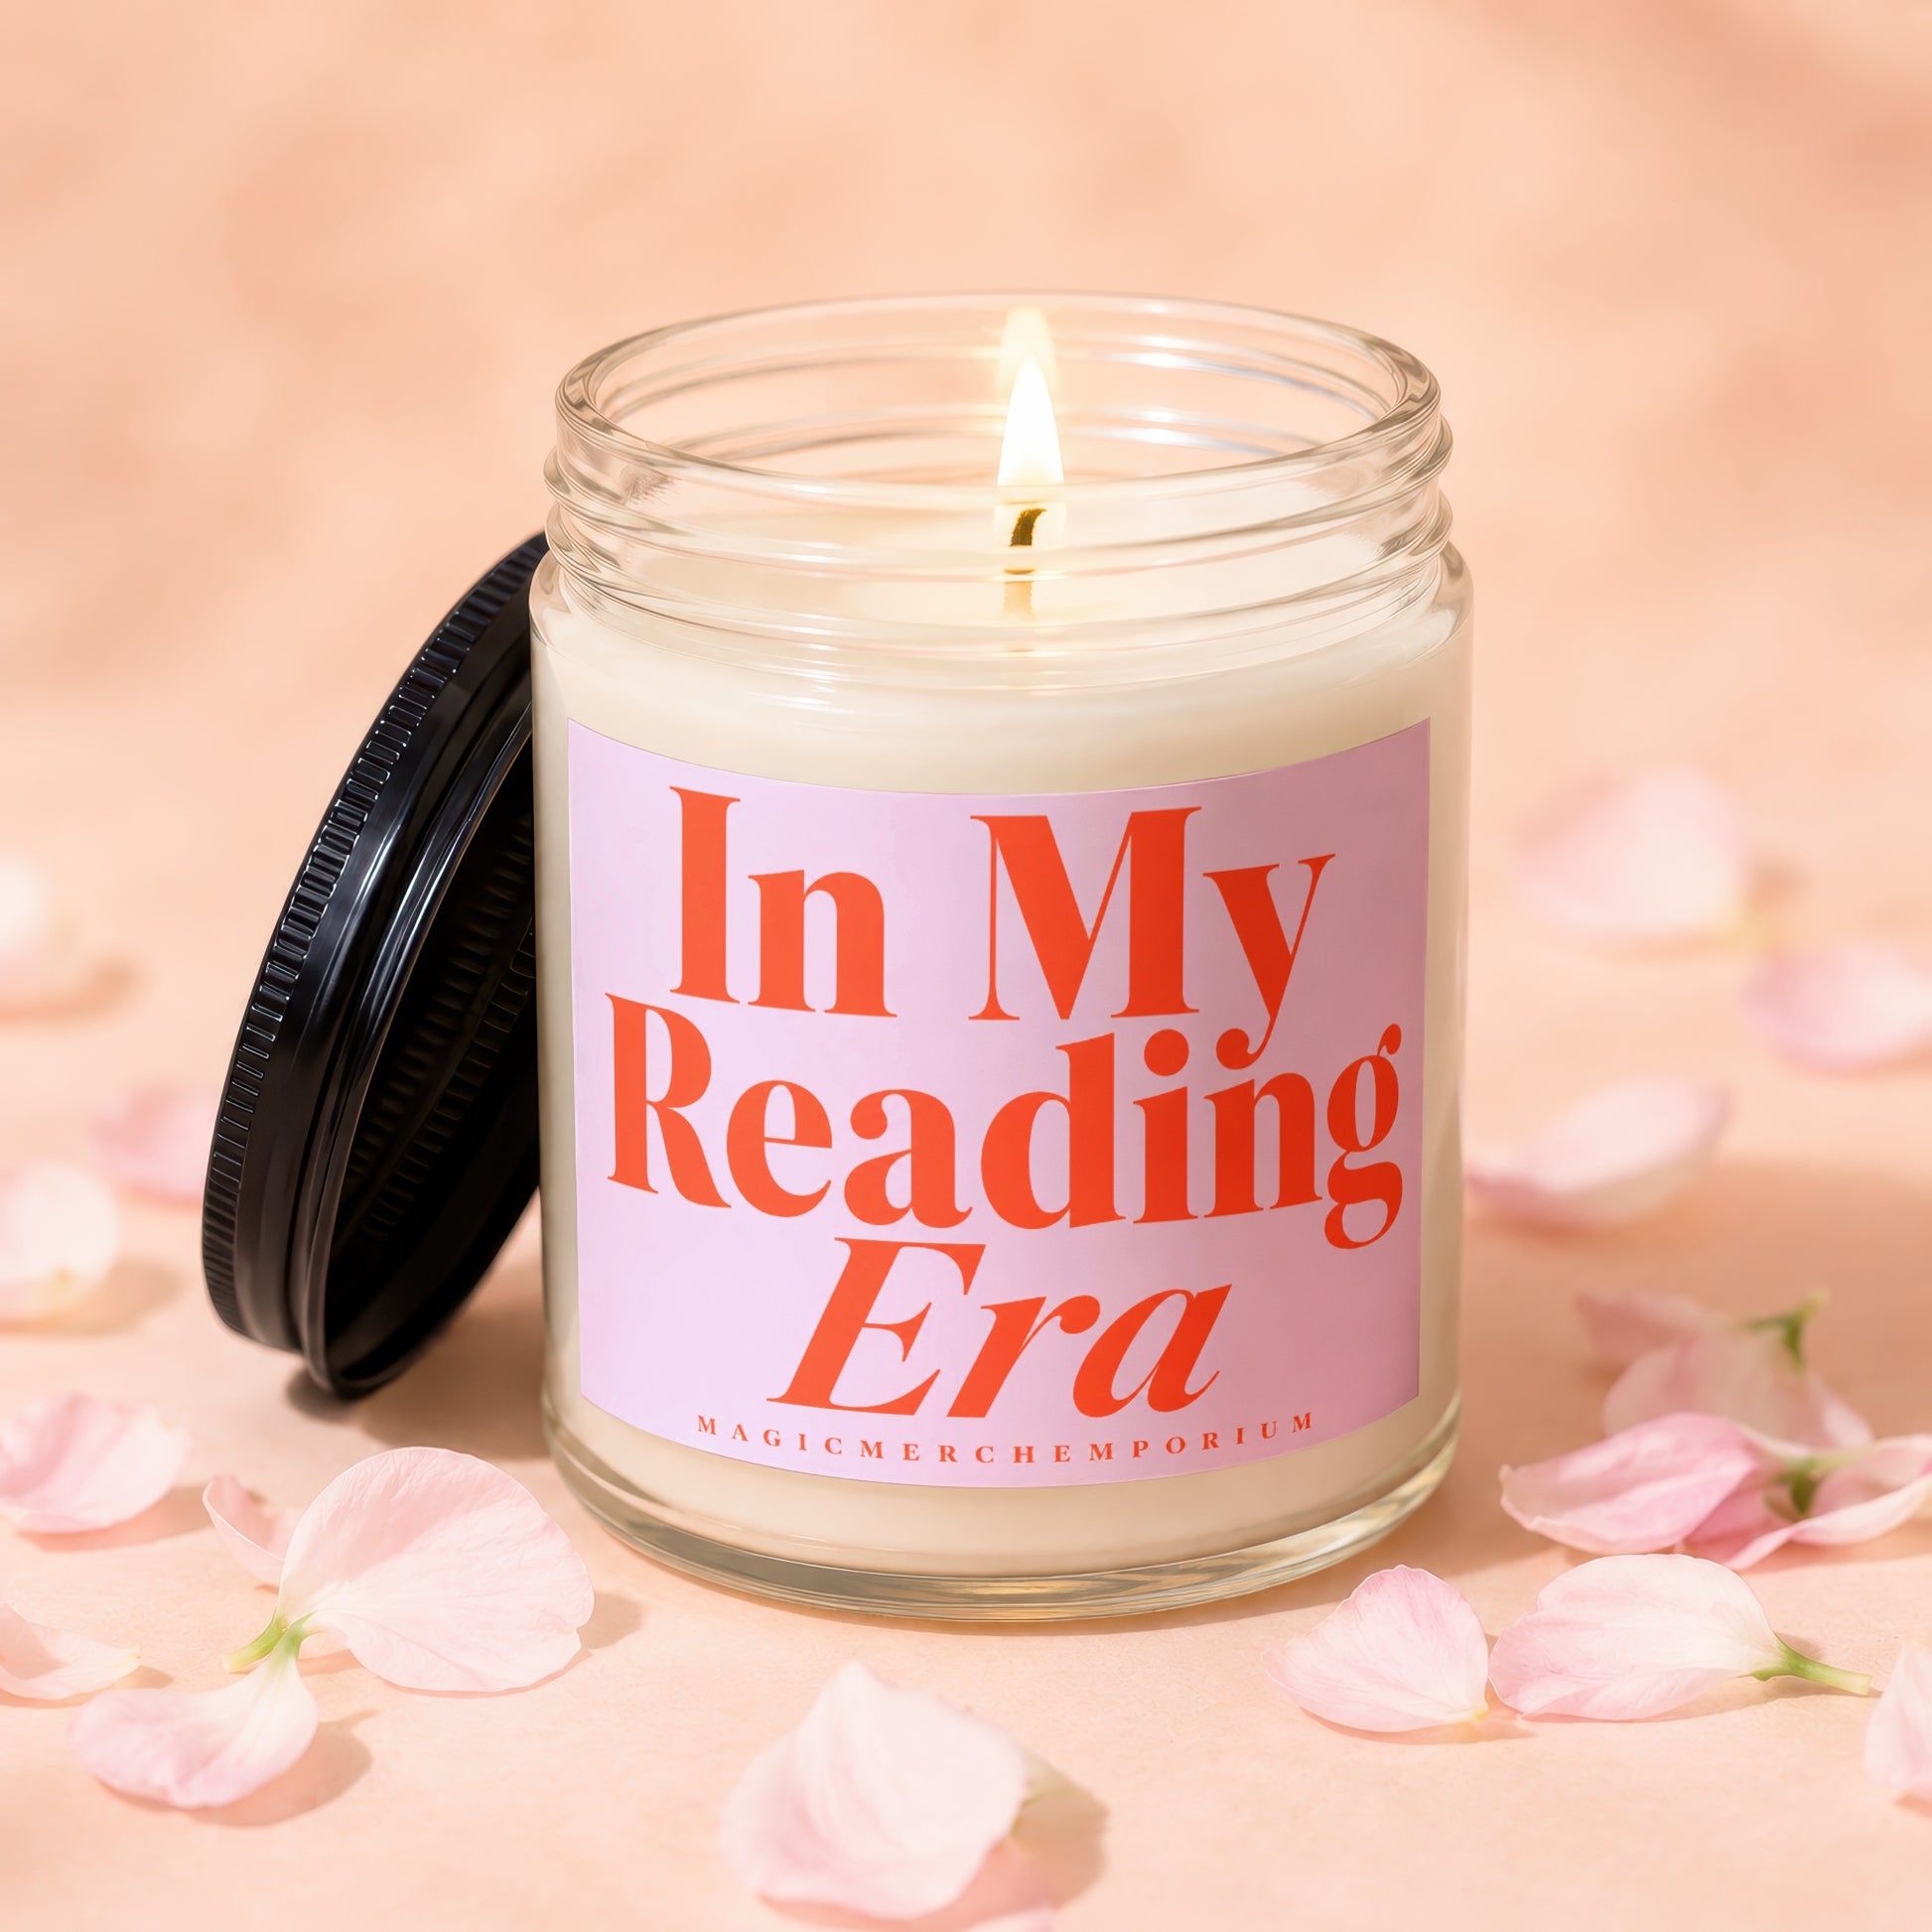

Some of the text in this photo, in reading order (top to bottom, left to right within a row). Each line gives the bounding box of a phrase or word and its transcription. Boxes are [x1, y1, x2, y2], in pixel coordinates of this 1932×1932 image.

[669, 785, 1336, 1071] In My
[605, 993, 1404, 1251] Reading
[697, 1412, 1313, 1463] MAGICMERCHEMPORIUM
[766, 1237, 1233, 1419] Era
